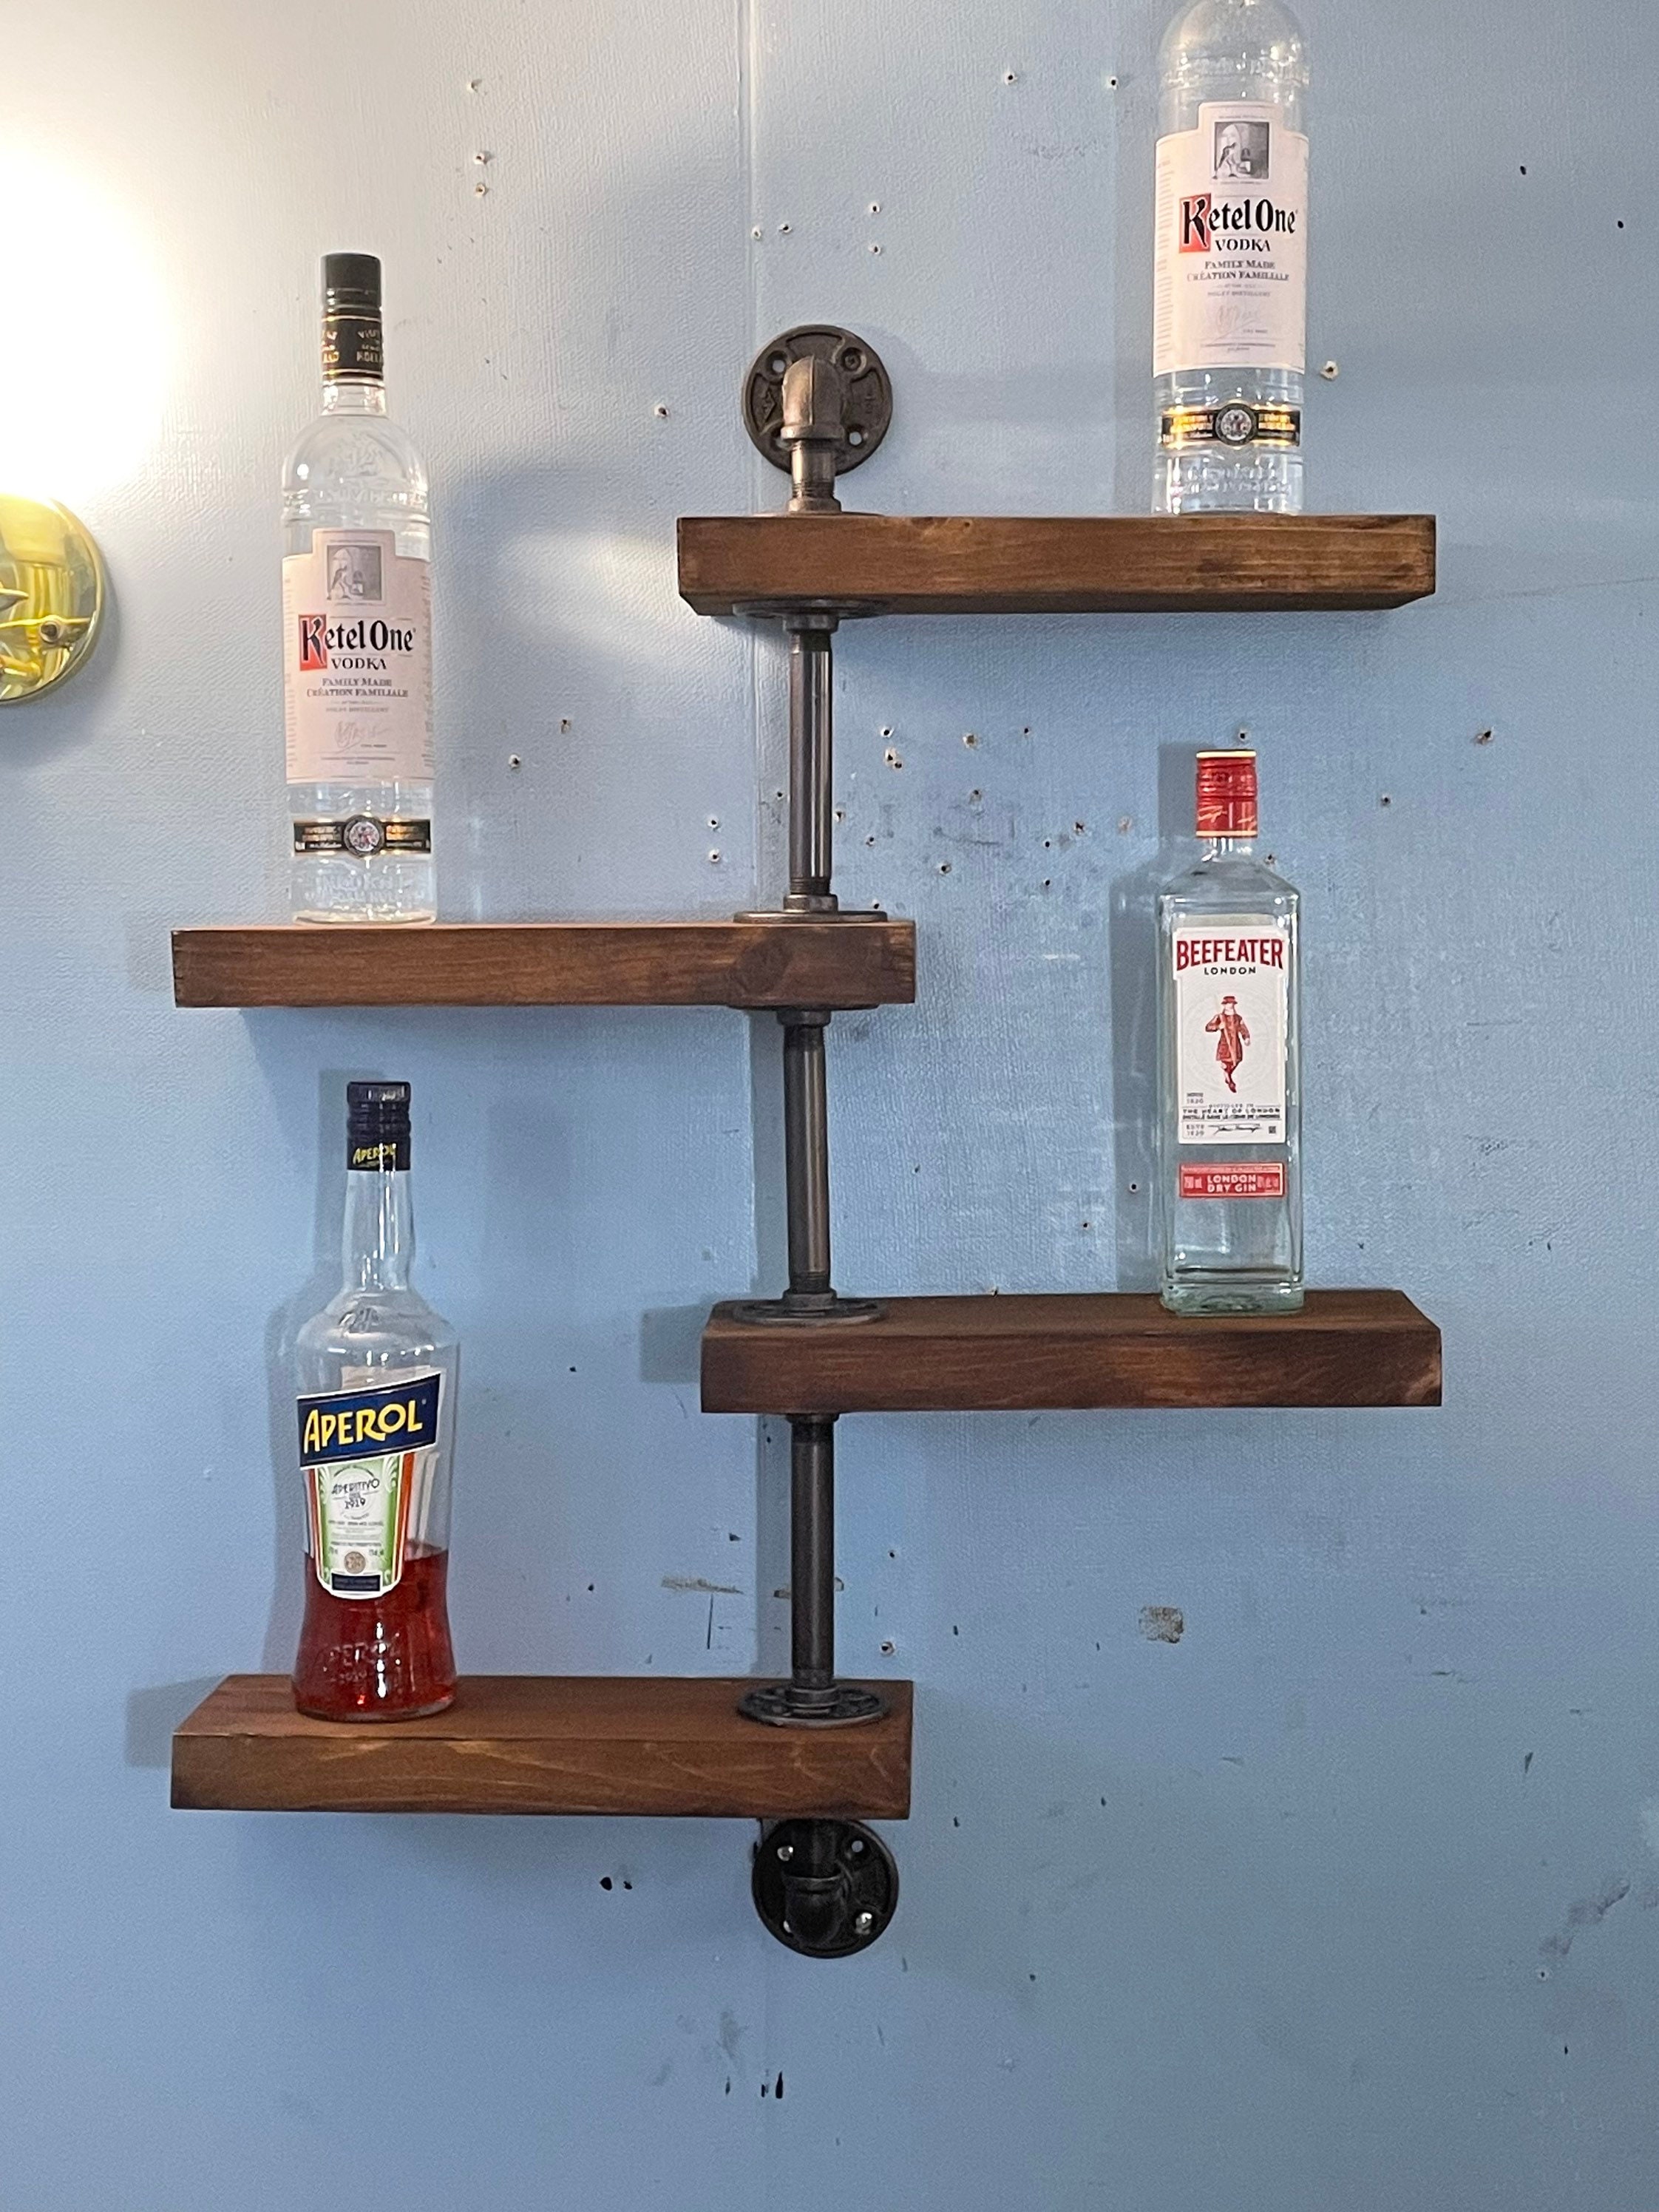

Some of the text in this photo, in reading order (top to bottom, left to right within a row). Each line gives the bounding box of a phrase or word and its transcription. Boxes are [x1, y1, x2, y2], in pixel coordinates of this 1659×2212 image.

[1183, 199, 1295, 247] Ketel One
[1215, 239, 1271, 251] VODKA
[302, 619, 413, 665] Ketel One
[331, 658, 387, 670] VODKA
[1176, 938, 1283, 971] BEEFEATER
[1204, 967, 1256, 975] LONDON
[1207, 1175, 1256, 1184] LONDON
[1207, 1184, 1231, 1192] DRY
[1235, 1184, 1256, 1192] GIN
[304, 1400, 423, 1453] APEROL
